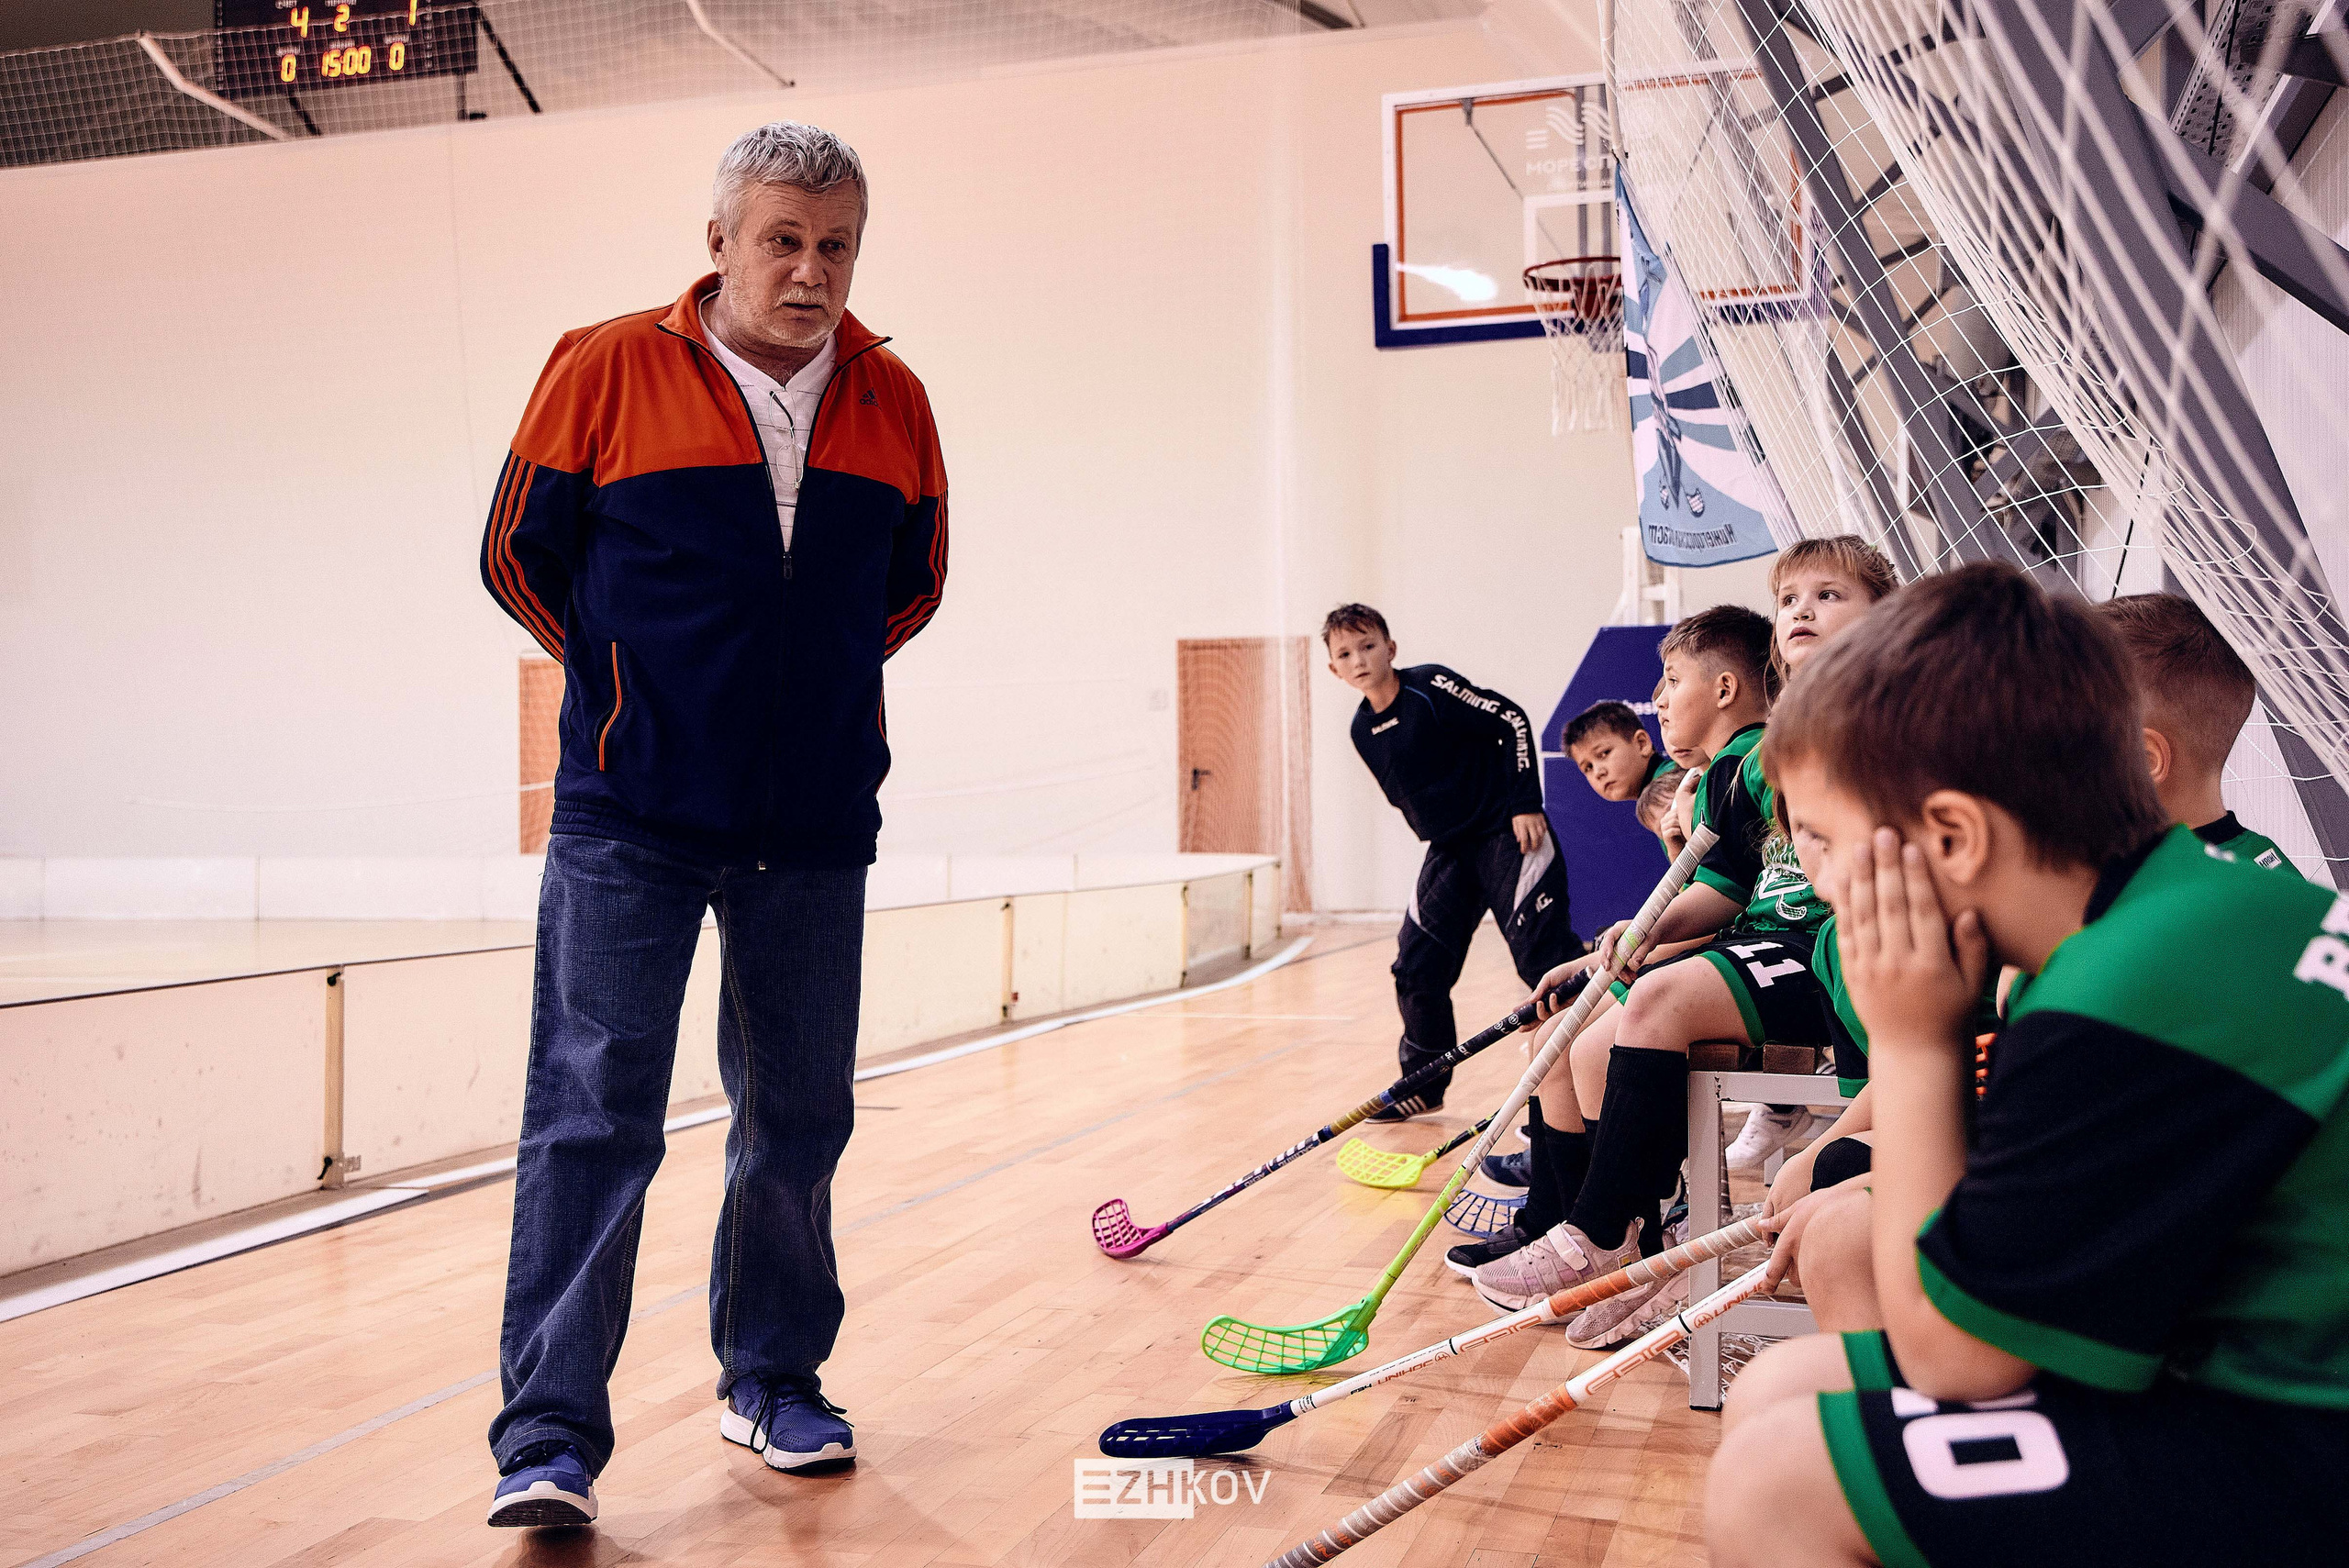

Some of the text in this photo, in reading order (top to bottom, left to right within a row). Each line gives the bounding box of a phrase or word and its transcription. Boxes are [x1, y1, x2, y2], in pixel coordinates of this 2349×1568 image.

[290, 6, 309, 39] 4
[333, 4, 351, 33] 2
[280, 53, 297, 83] 0
[388, 41, 406, 71] 0
[1431, 673, 1501, 714] SALMING
[1726, 941, 1807, 988] 11
